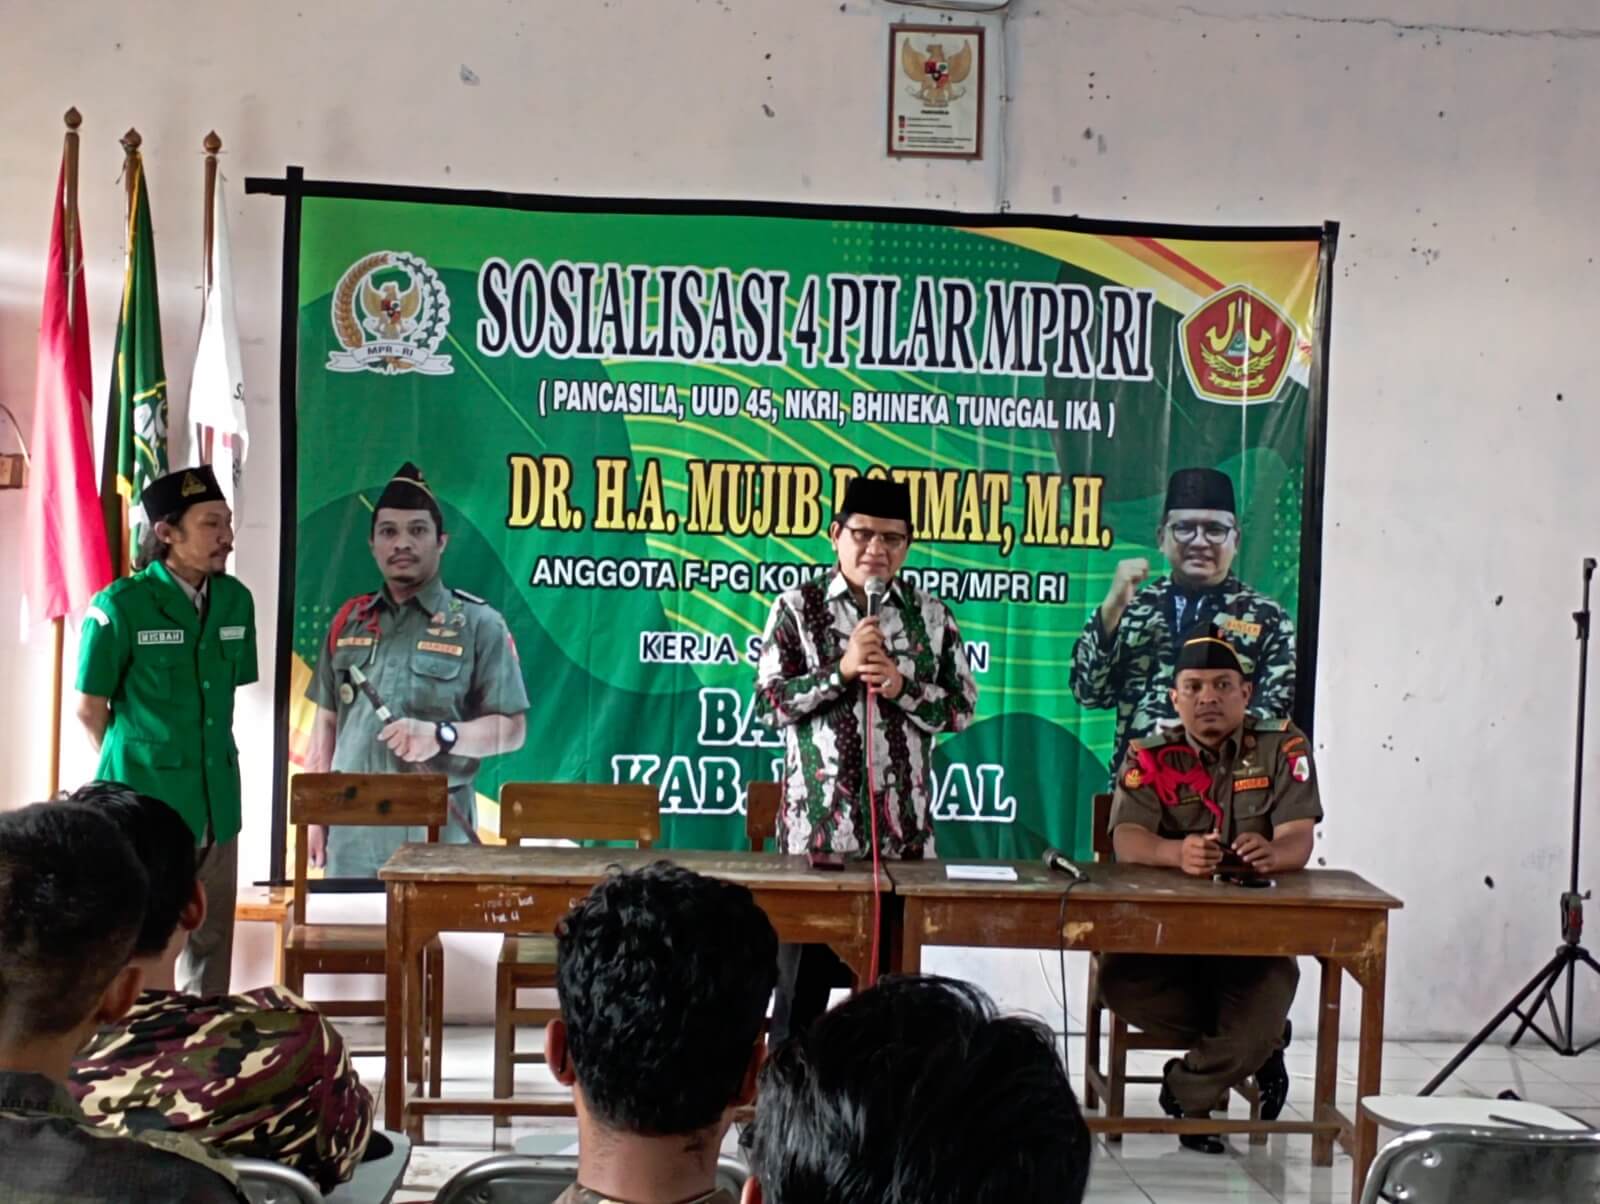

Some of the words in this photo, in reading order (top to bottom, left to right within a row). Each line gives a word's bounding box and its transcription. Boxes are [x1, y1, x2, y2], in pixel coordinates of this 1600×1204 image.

[478, 257, 788, 365] SOSIALISASI
[793, 276, 816, 367] 4
[826, 273, 975, 374] PILAR
[982, 280, 1093, 379] MPR
[1098, 285, 1155, 381] RI
[367, 346, 393, 355] MPR
[553, 380, 684, 420] PANCASILA,
[691, 383, 739, 416] UUD
[745, 387, 778, 424] 45,
[785, 389, 846, 427] NKRI,
[852, 391, 949, 424] BHINEKA
[956, 396, 1059, 429] TUNGGAL
[1065, 400, 1102, 431] IKA
[507, 454, 584, 531] DR.
[594, 457, 678, 533] H.A.
[685, 460, 823, 537] MUJIB
[1021, 474, 1115, 550] M.H.
[531, 557, 677, 590] ANGGOTA
[683, 561, 752, 592] F-PG
[1037, 573, 1068, 602] RI
[639, 631, 738, 664] KERJA
